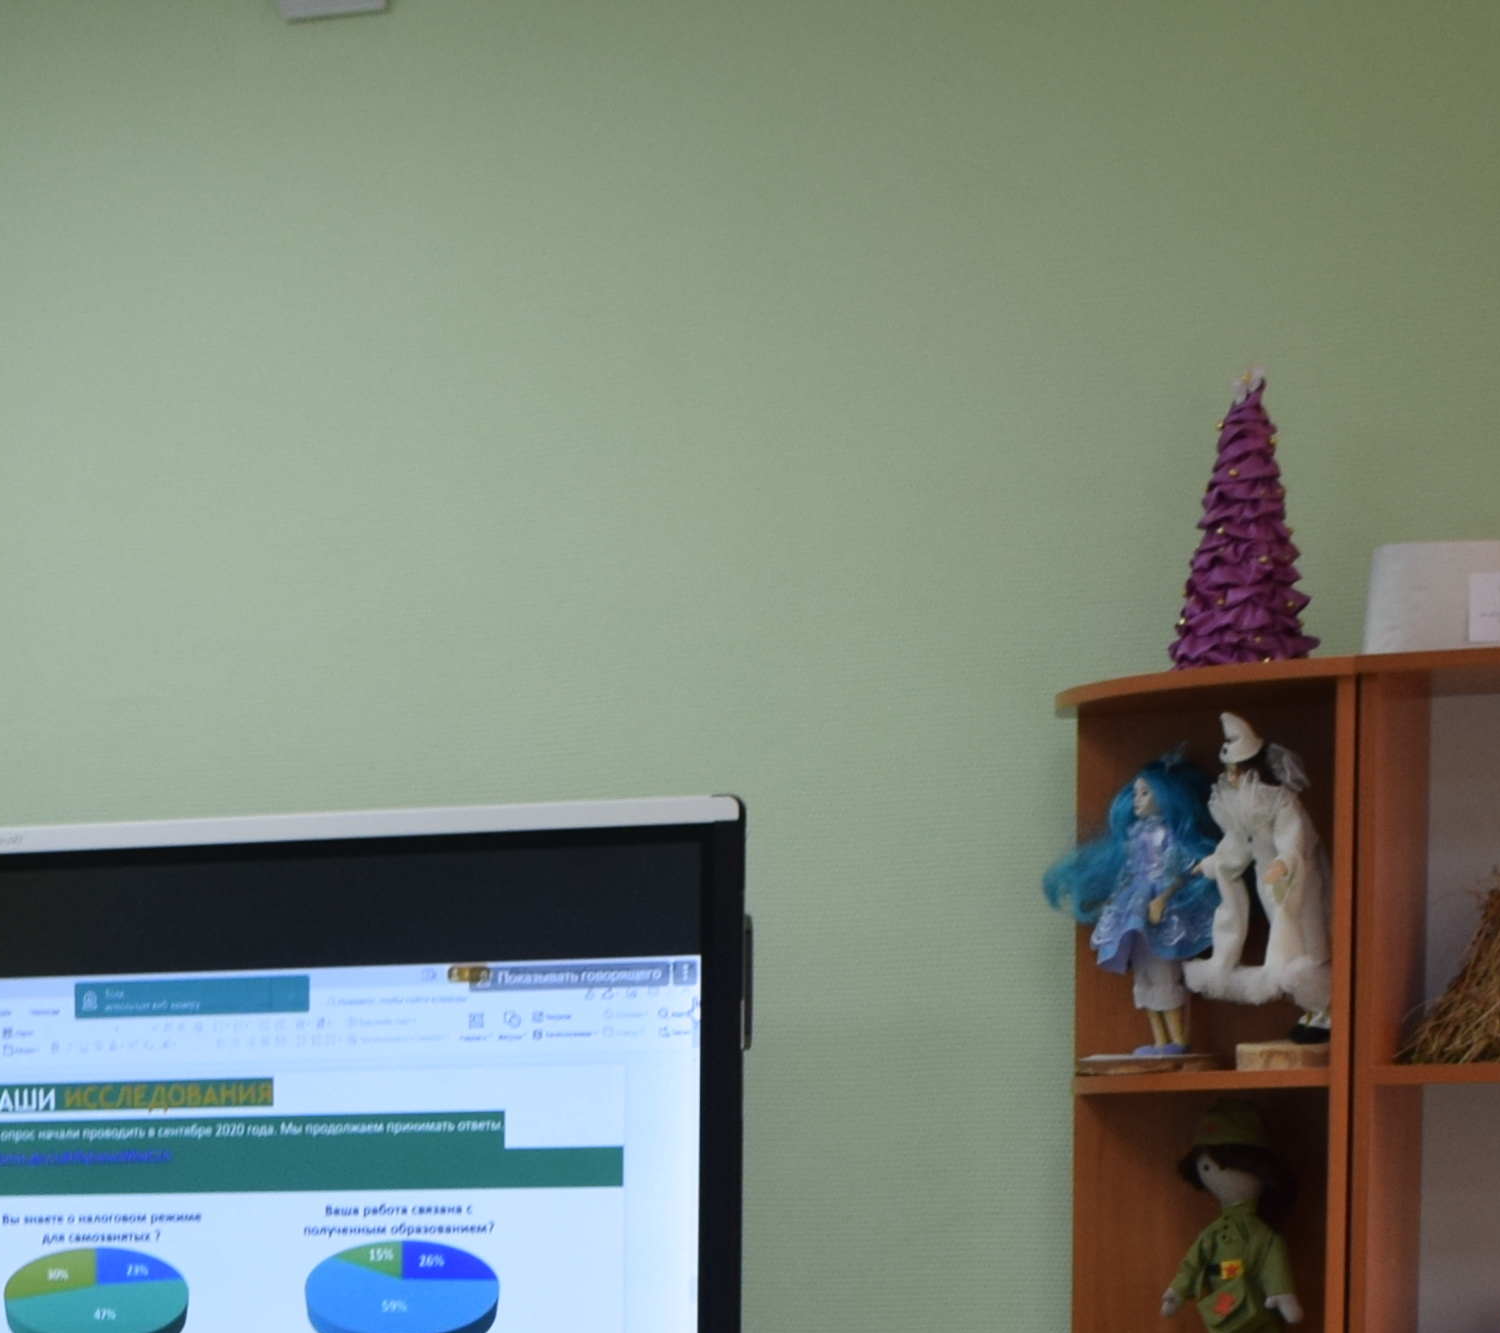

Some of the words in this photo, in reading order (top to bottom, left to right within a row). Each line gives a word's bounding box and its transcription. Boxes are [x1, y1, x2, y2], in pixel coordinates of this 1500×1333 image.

[498, 968, 579, 986] Показывать
[580, 967, 662, 985] говорящего
[64, 1081, 273, 1113] ИССЛЕДОВАНИЯ
[1, 1128, 36, 1145] опрос
[37, 1127, 79, 1142] начали
[81, 1126, 146, 1143] проводить
[157, 1121, 213, 1142] сентябре
[214, 1122, 245, 1138] 2020
[246, 1124, 278, 1141] года.
[280, 1121, 302, 1136] Мы
[304, 1120, 384, 1139] продолжаем
[386, 1119, 454, 1136] принимать
[1, 1212, 20, 1226] Вы
[23, 1212, 64, 1226] знаете
[78, 1212, 147, 1225] налоговом
[149, 1212, 202, 1228] режиме
[324, 1203, 360, 1217] Ваша
[362, 1203, 407, 1219] работа
[410, 1204, 463, 1216] связана
[41, 1233, 65, 1246] для
[67, 1231, 151, 1244] самозанятых
[303, 1224, 387, 1238] полученным
[389, 1221, 496, 1238] образованием?
[368, 1247, 394, 1263] 15%
[418, 1253, 445, 1268] 26%
